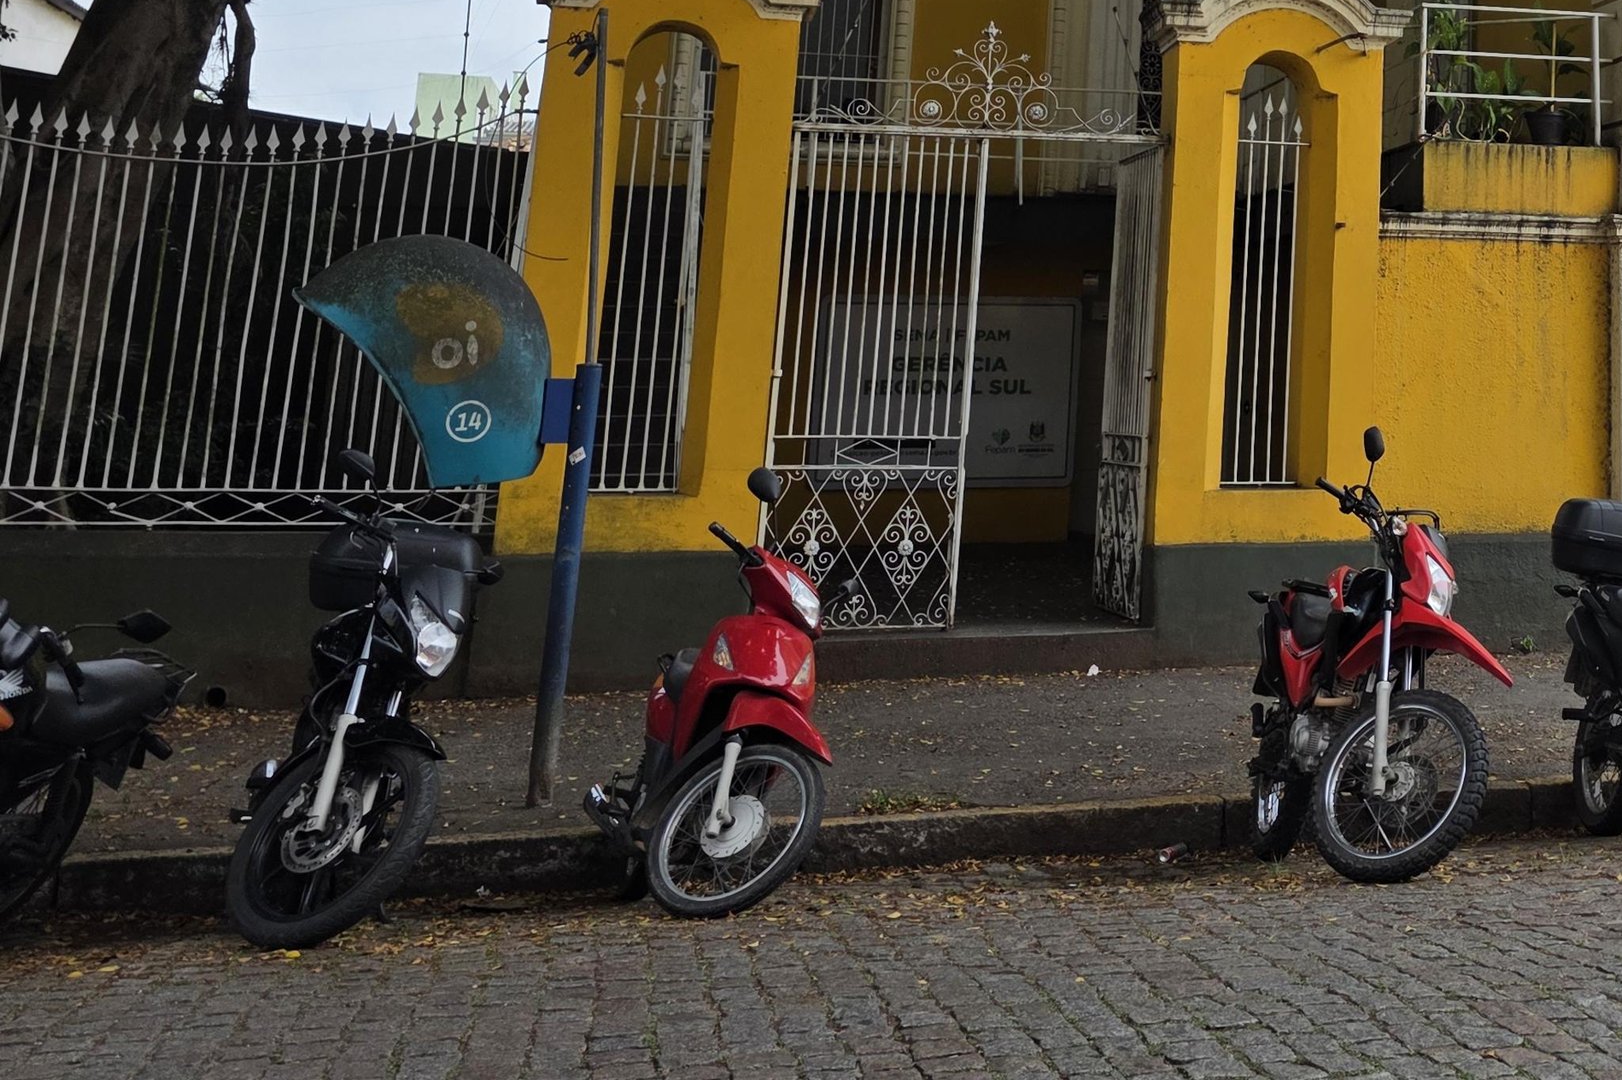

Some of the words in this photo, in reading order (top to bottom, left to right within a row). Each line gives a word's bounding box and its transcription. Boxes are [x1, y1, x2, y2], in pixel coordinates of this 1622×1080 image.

[955, 328, 1011, 342] FPAM
[431, 320, 479, 369] oi
[989, 379, 1032, 395] SUL
[455, 411, 482, 432] 14
